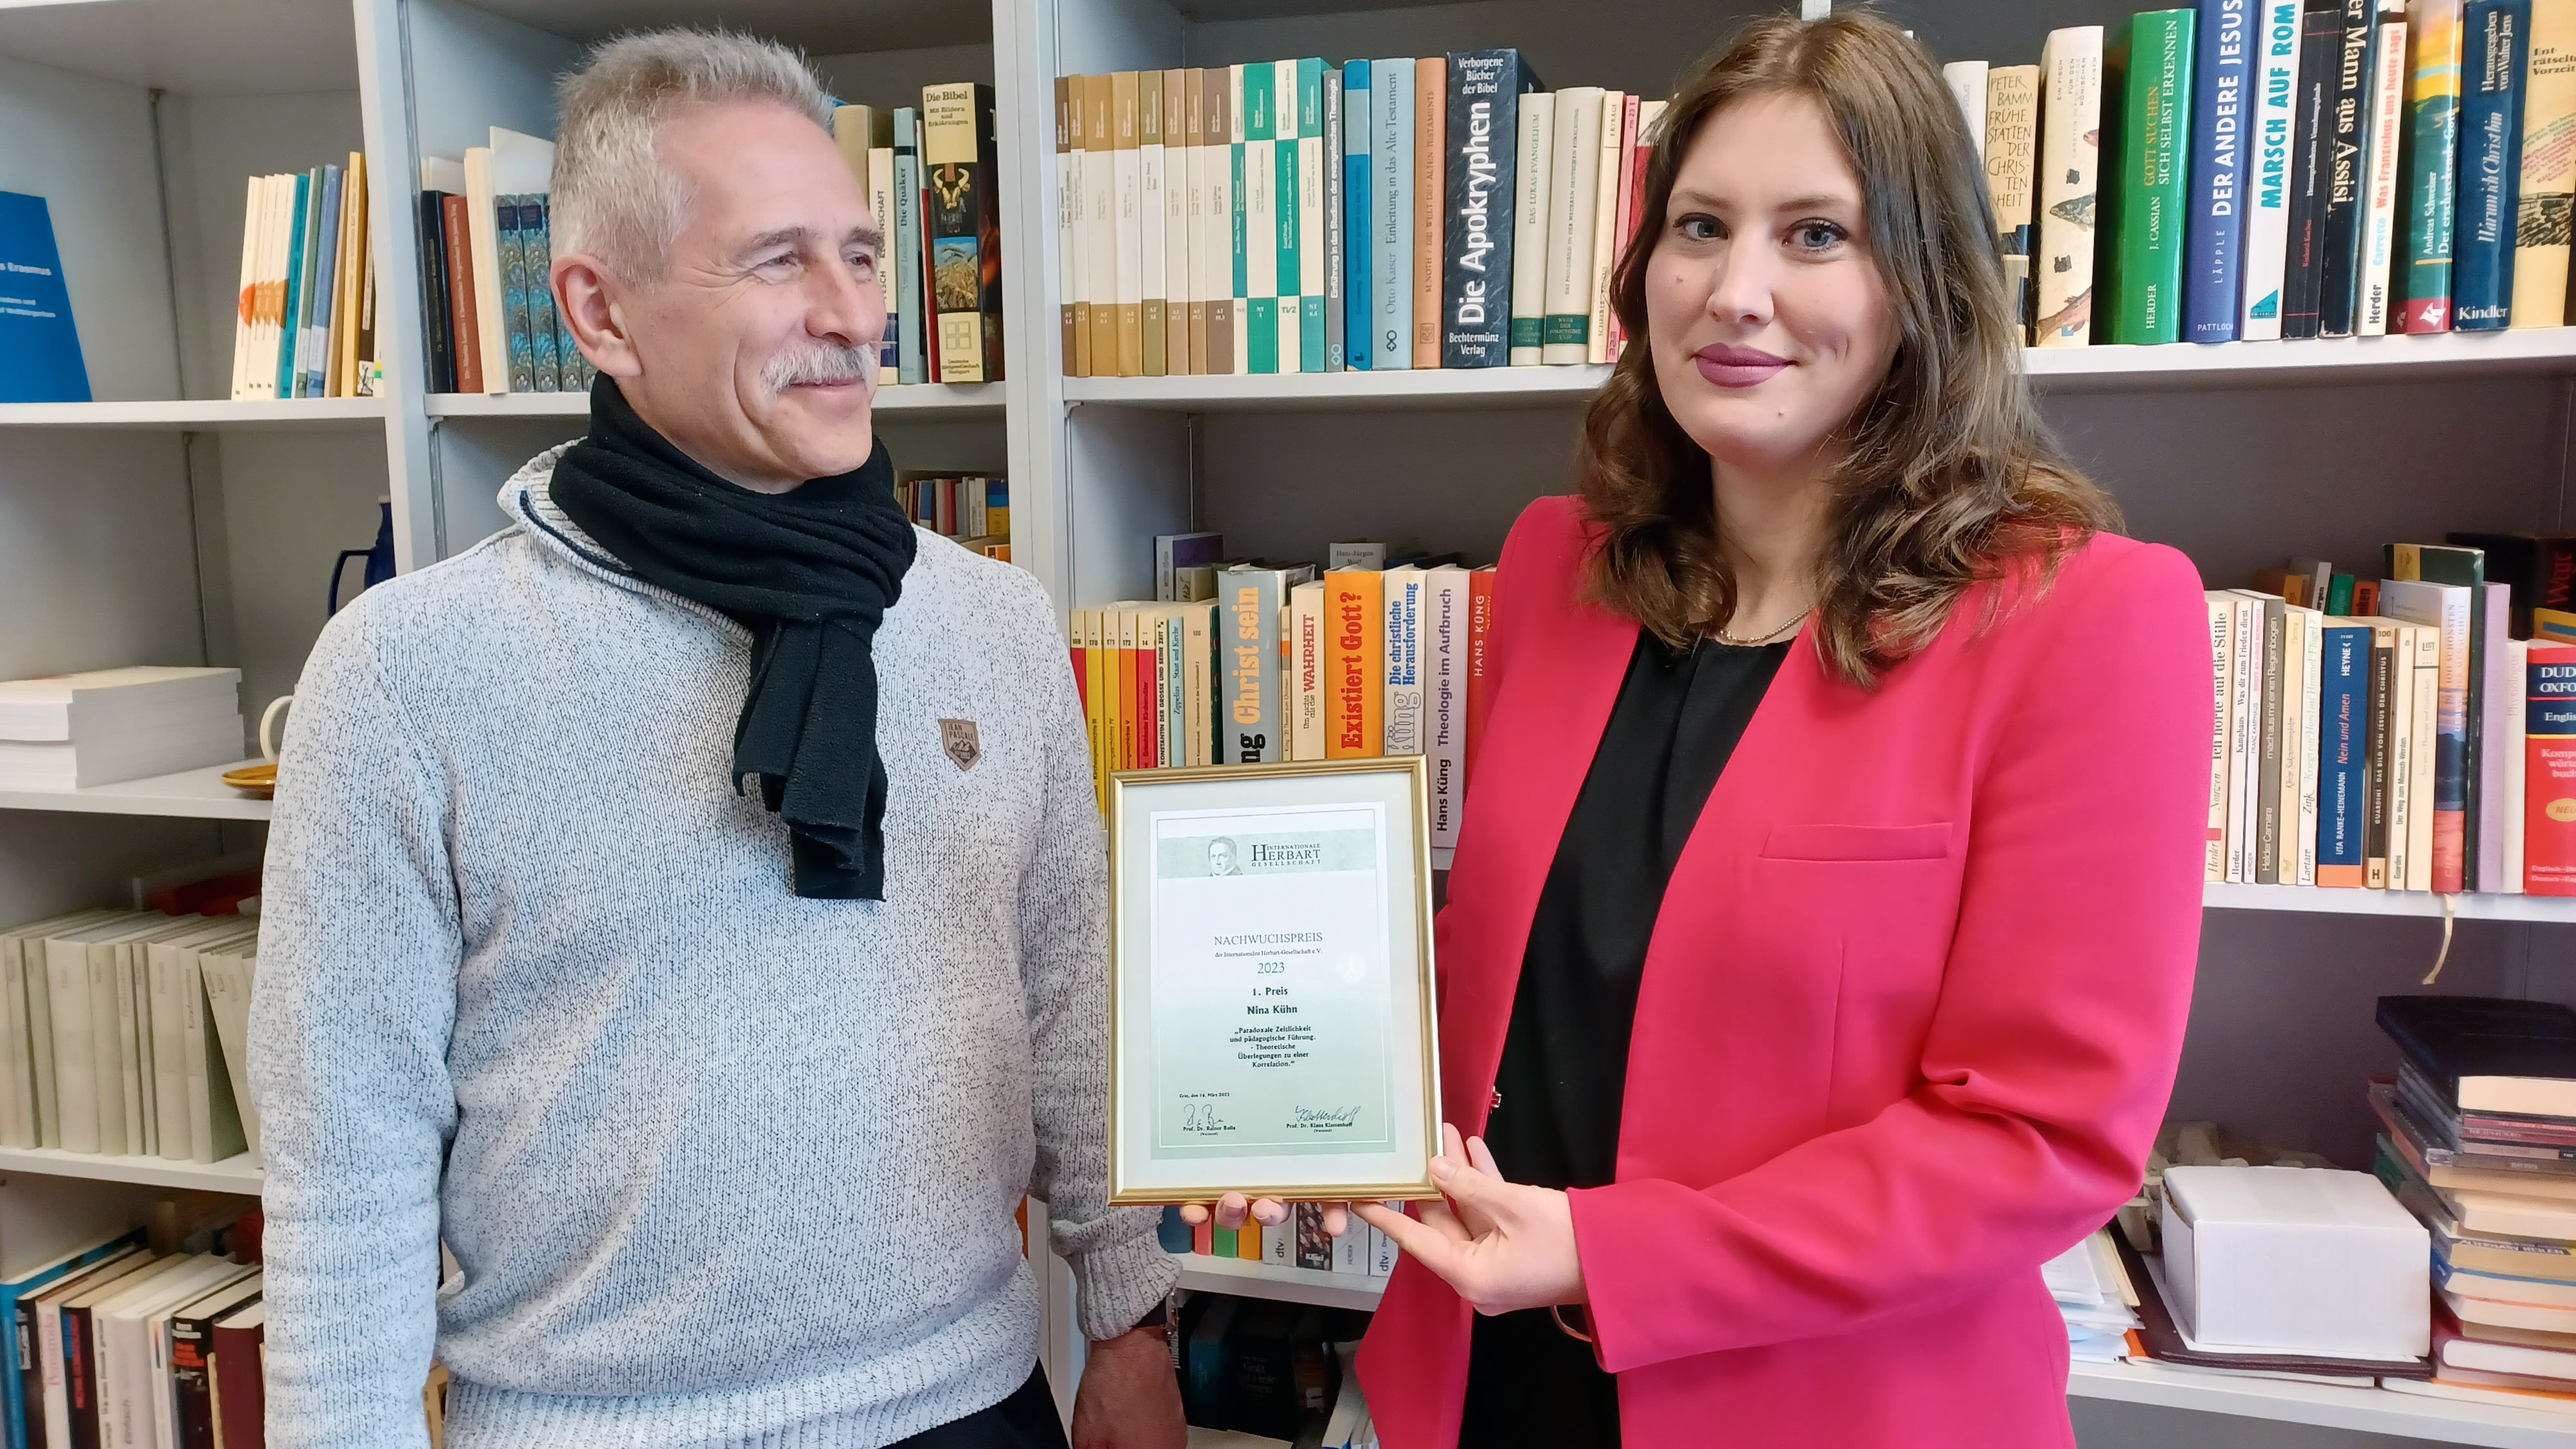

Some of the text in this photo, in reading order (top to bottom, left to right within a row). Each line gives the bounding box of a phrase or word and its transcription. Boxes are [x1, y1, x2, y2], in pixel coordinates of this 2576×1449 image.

[1458, 56, 1503, 68] Verborgene
[2481, 11, 2498, 91] Herausgegeben
[2497, 14, 2513, 91] von Walter Jens
[1466, 69, 1494, 82] Bücher
[2533, 66, 2575, 75] Vorzeit
[927, 91, 967, 102] Die Bibel
[1463, 82, 1497, 94] der Bibel
[1991, 75, 2027, 93] PETER
[1329, 79, 1339, 120] Theologie
[1998, 92, 2033, 106] BAMM
[2159, 20, 2177, 185] SICH SELBST ERKENNEN
[2211, 0, 2243, 216] DER ANDERE JESUS
[2260, 3, 2296, 208] MARSCH AUF ROM
[1989, 108, 2027, 126] FRÜHE
[2333, 25, 2368, 204] Mann aus Assisi
[2375, 29, 2402, 209] Was Franziskus uns heute sagt
[2007, 142, 2031, 156] DER
[2144, 86, 2159, 187] GOTT SUCHEN
[1426, 152, 1434, 180] ALTEN
[1530, 115, 1540, 204] LUKAS-EVANGELIUM
[1987, 156, 2030, 176] CHRIS-
[1329, 180, 1338, 194] der
[2005, 176, 2027, 191] TEN
[2477, 112, 2503, 242] Warum ich Christ bin
[1385, 73, 1398, 314] Otto Einleitung in das Alte Testament
[1997, 193, 2024, 207] HEIT
[1458, 102, 1497, 324] Die Apokryphen
[2149, 196, 2160, 241] CASSIAN
[1330, 231, 1338, 245] das
[2423, 219, 2436, 255] Andreas
[2437, 230, 2450, 254] Der
[2213, 230, 2226, 283] LÄPPLE
[1330, 256, 1340, 298] Einführung
[2146, 284, 2157, 328] HERDER
[2369, 285, 2382, 324] Herder
[2459, 305, 2508, 320] Kindler
[1449, 332, 1499, 345] Bechtermünz
[1460, 345, 1485, 357] Verlag
[2239, 610, 2248, 629] dient
[1389, 601, 1402, 685] Die christliche
[1403, 583, 1418, 686] Herausforderung
[1473, 595, 1484, 676] HANS KÜNG
[2213, 613, 2227, 672] die Stille
[2268, 617, 2279, 676] Regenbogen
[1232, 587, 1261, 724] Christ sein
[1303, 614, 1314, 693] WAHRHEIT
[2341, 647, 2351, 676] HEYNE
[1340, 592, 1363, 749] Existiert Gott?
[1437, 589, 1452, 747] Theologie im Aufbruch
[2238, 678, 2246, 688] dir
[1173, 686, 1182, 715] Zippelius
[2237, 690, 2246, 705] Was
[949, 731, 974, 741] PASCALE
[1303, 717, 1310, 729] Um
[1387, 691, 1421, 755] Küng
[2235, 717, 2246, 753] Kamphaus
[2335, 694, 2351, 855] UTA RANKE-HEINEMANN Nein und Amen
[1436, 759, 1451, 831] Hans Küng
[2302, 790, 2315, 814] Zink
[2396, 800, 2405, 813] Weg
[1251, 844, 1321, 862] HERBART
[2231, 850, 2241, 875] Herder
[1214, 932, 1323, 945] NACHWUCHSPREIS
[1257, 961, 1285, 974] 2023
[1253, 986, 1288, 996] 1. Preis
[1247, 1005, 1298, 1015] Nina Kühn
[1244, 1034, 1286, 1043] pädagogische
[1288, 1034, 1316, 1042] Führung.
[1238, 1052, 1282, 1061] Überlegungen
[1275, 1241, 1284, 1258] dtv
[1379, 1255, 1389, 1272] dtv
